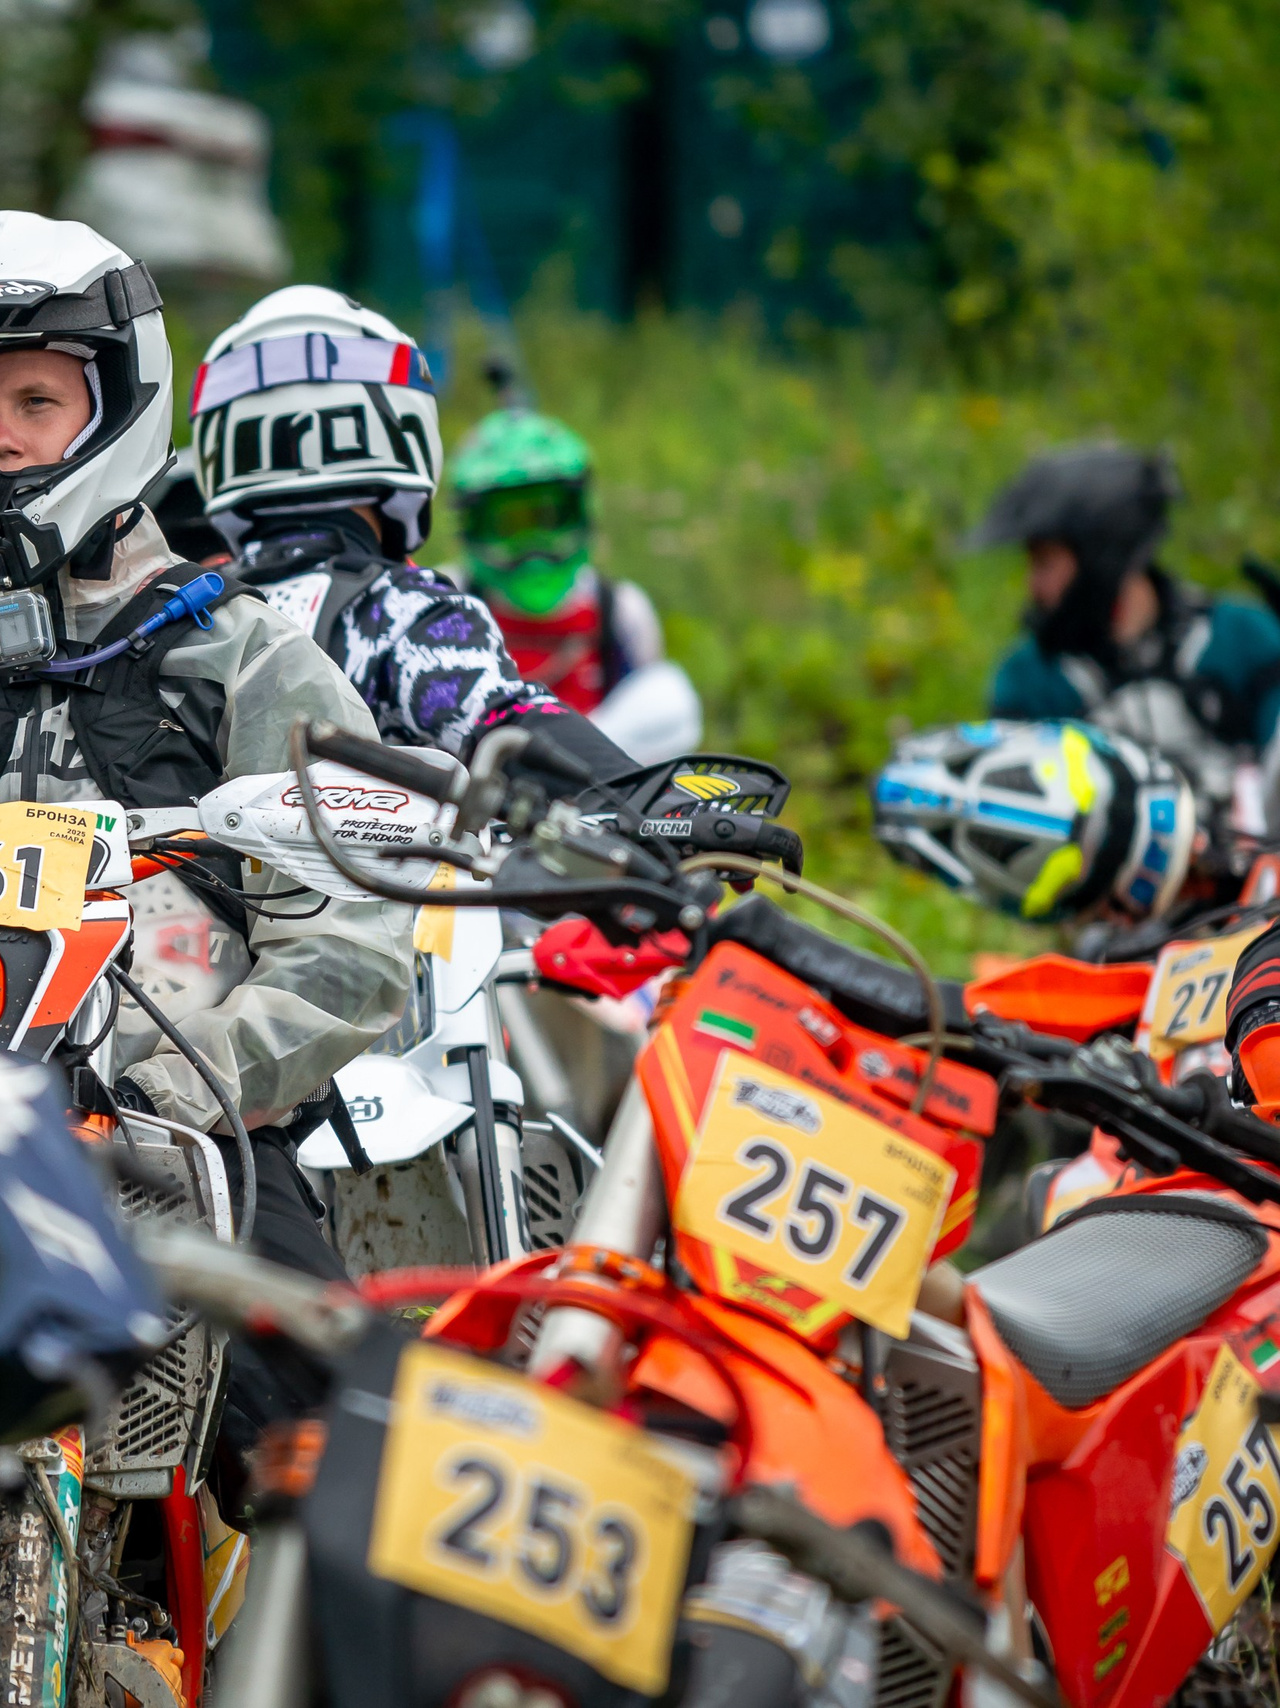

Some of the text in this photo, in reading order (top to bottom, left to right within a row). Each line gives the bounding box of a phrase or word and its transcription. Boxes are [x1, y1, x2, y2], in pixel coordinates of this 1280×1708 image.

[25, 808, 87, 828] БРОНЗА
[340, 819, 418, 833] PROTECTION
[66, 828, 86, 838] 2025
[640, 819, 692, 836] CYCRA
[49, 831, 85, 845] САМАРА
[332, 830, 413, 845] FOR ENDURO
[1165, 971, 1229, 1038] 27
[721, 1139, 906, 1288] 257
[435, 1455, 642, 1624] 253
